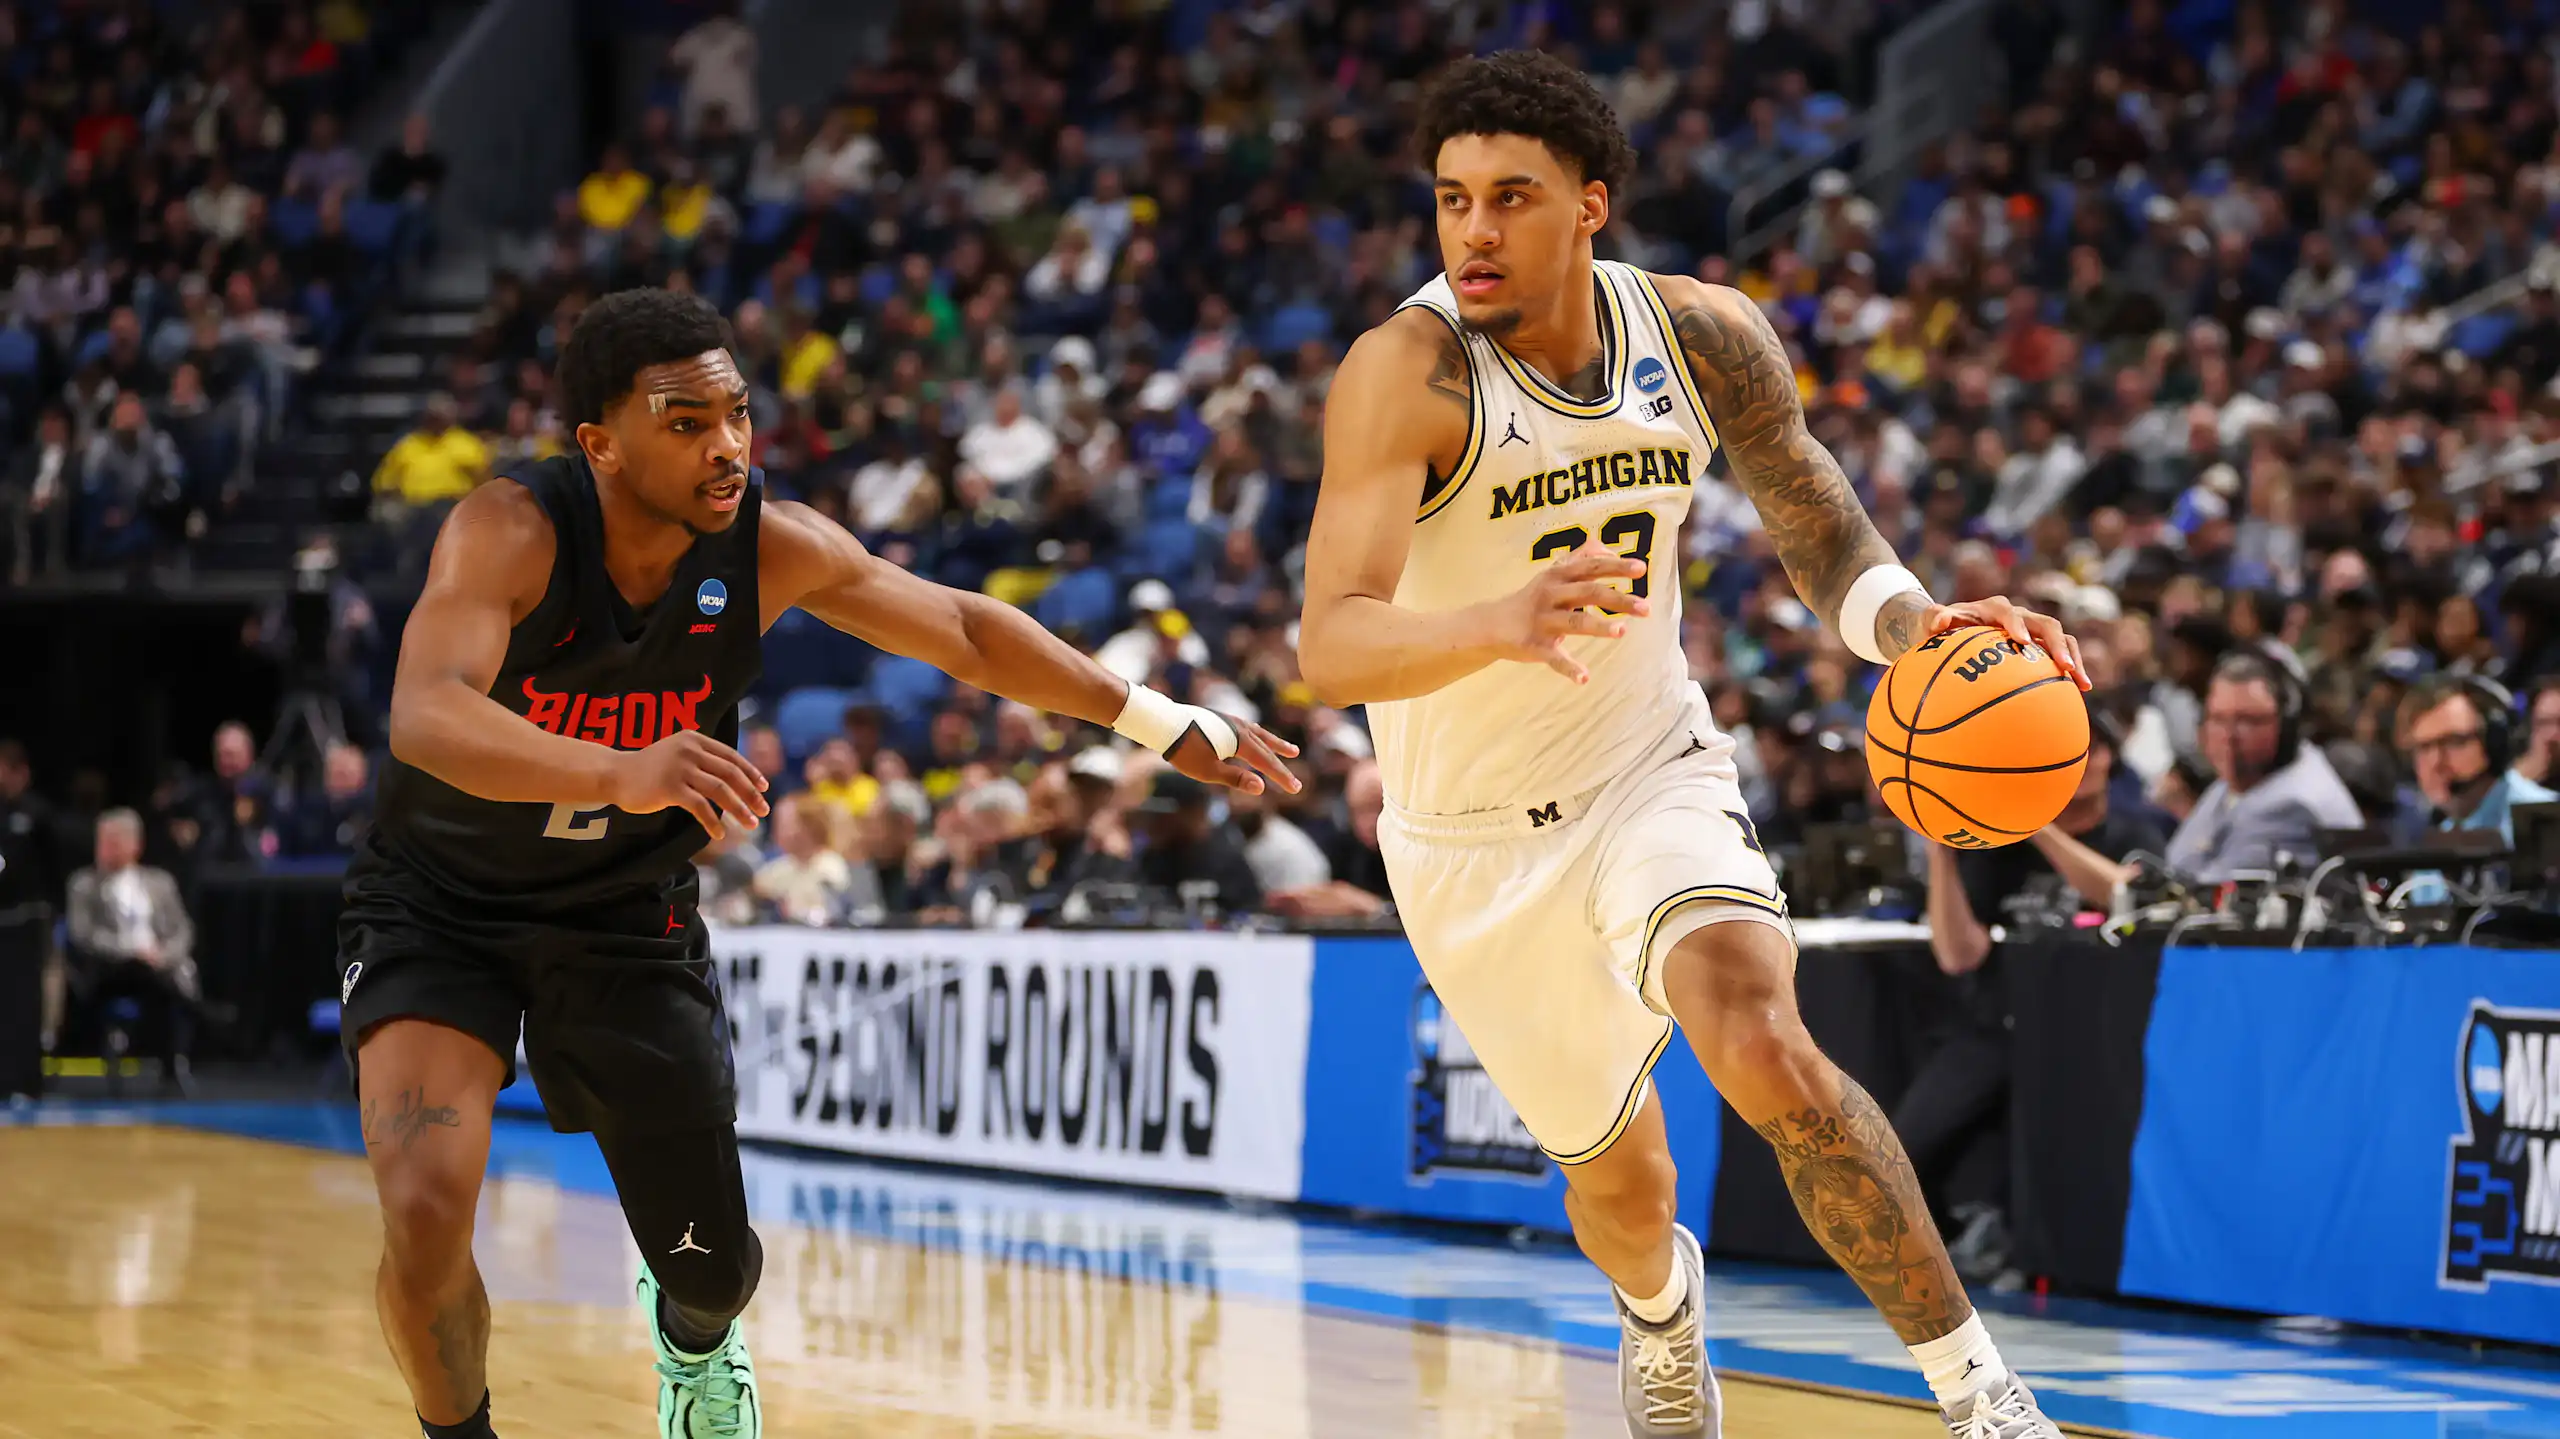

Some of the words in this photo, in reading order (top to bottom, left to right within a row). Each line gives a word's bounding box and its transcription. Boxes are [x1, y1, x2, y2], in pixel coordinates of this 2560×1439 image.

[1638, 369, 1665, 388] NCAA
[1488, 448, 1692, 520] MICHIGAN
[700, 594, 725, 608] NCAA
[522, 673, 712, 752] BISON
[1527, 801, 1562, 828] M
[794, 955, 964, 1136] SECOND
[983, 962, 1220, 1157] ROUNDS
